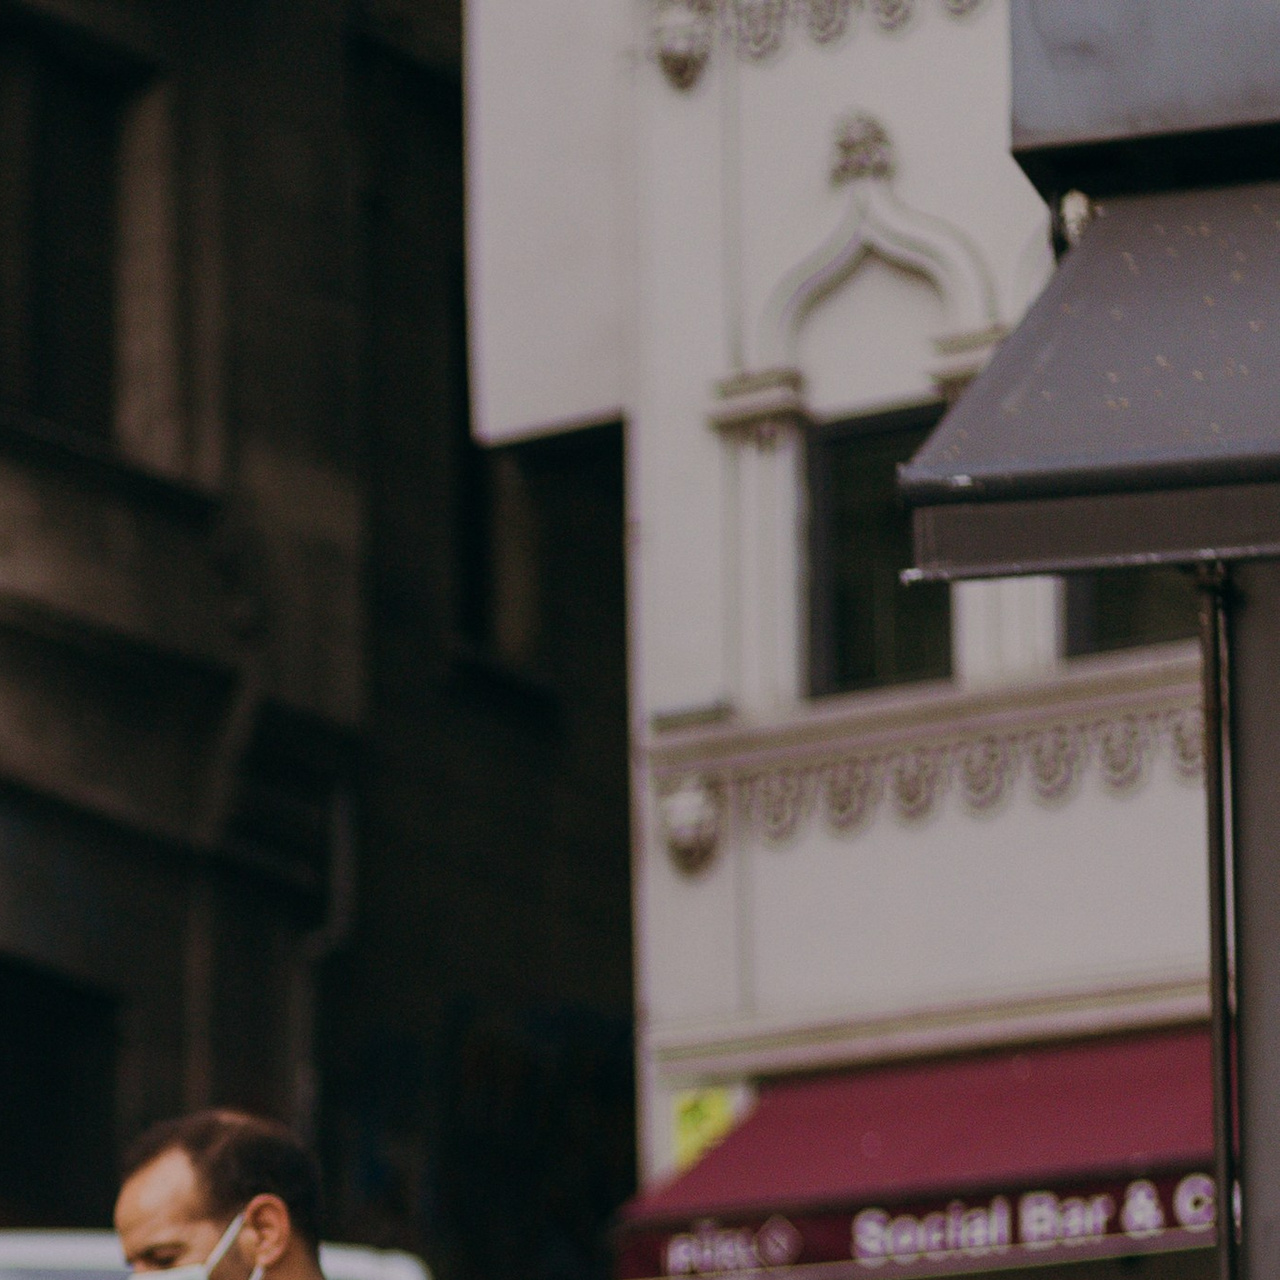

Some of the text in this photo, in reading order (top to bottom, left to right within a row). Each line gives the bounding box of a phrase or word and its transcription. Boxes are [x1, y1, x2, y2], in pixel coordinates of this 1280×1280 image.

[851, 1195, 1012, 1269] Social
[1020, 1190, 1116, 1249] Bar
[1122, 1179, 1164, 1239] &
